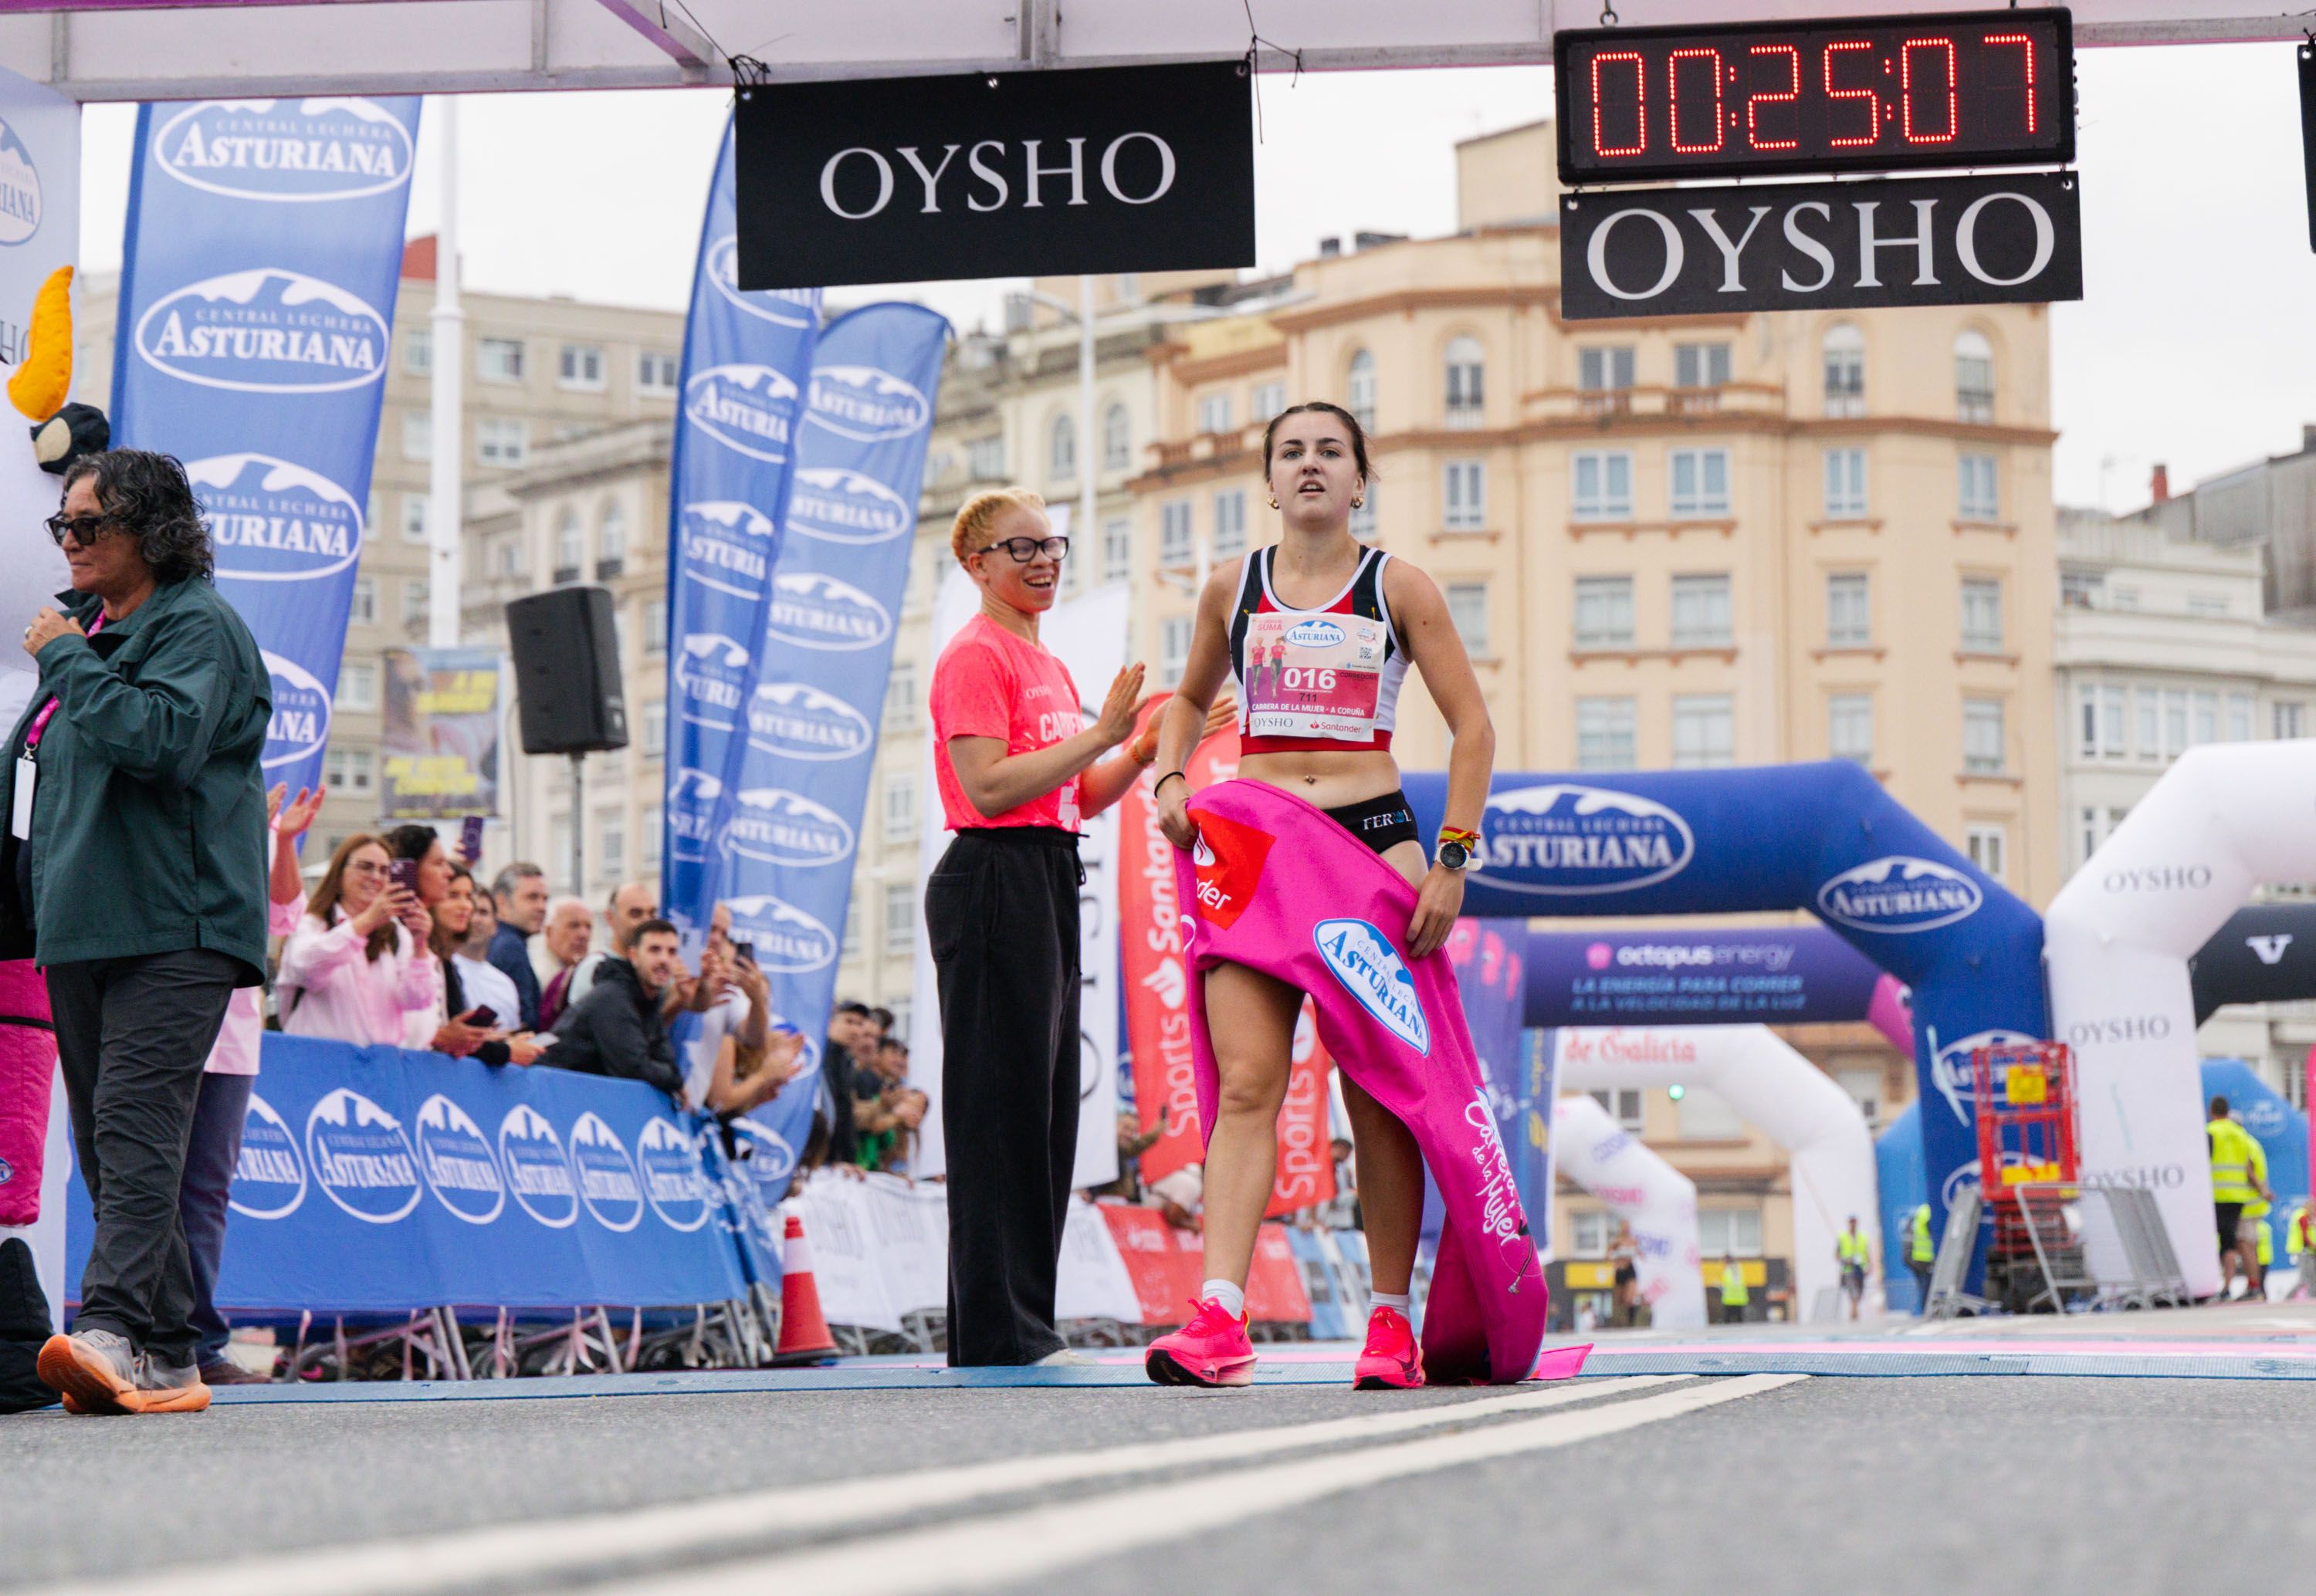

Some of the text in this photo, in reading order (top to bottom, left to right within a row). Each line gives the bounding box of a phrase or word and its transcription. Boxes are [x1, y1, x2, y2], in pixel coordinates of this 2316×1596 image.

[171, 120, 398, 178] ASTURIANA
[819, 132, 1177, 219] OYSHO
[1586, 192, 2055, 300] OYSHO
[152, 309, 375, 371] ASTURIANA
[1289, 630, 1341, 642] ASTURIANA
[1283, 668, 1336, 689] 016
[1299, 692, 1318, 702] 711
[1337, 705, 1365, 717] CORUÑA
[1254, 717, 1294, 728] OYSHO
[1321, 722, 1362, 733] Santander
[2103, 864, 2213, 894] OYSHO
[1833, 887, 1969, 917] ASTURIANA
[2068, 1015, 2172, 1047] OYSHO
[1160, 1013, 1201, 1138] Sports
[1276, 1068, 1322, 1199] Sports
[1471, 1144, 1486, 1165] de
